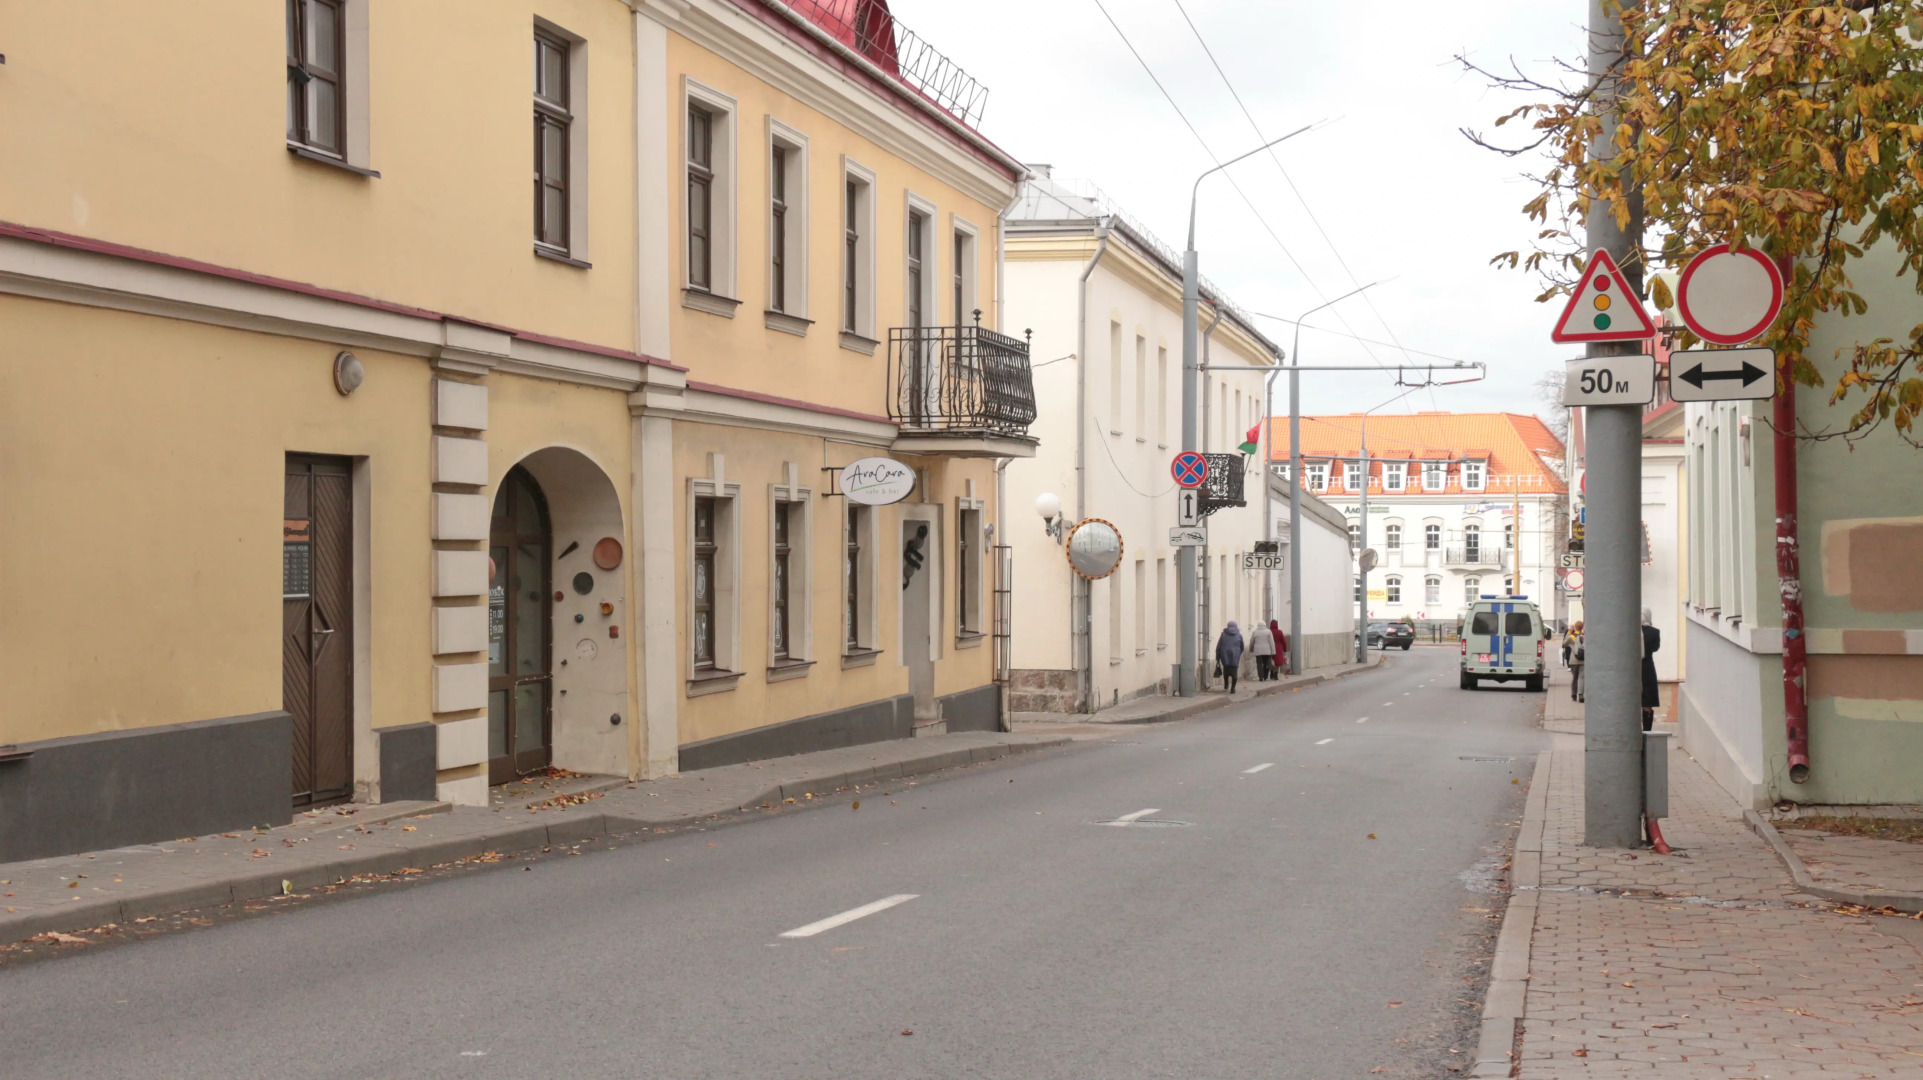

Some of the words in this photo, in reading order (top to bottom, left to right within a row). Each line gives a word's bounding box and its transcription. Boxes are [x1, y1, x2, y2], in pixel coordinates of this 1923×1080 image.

[1580, 368, 1613, 394] 50
[1245, 556, 1282, 568] STOP
[1563, 555, 1585, 567] ST
